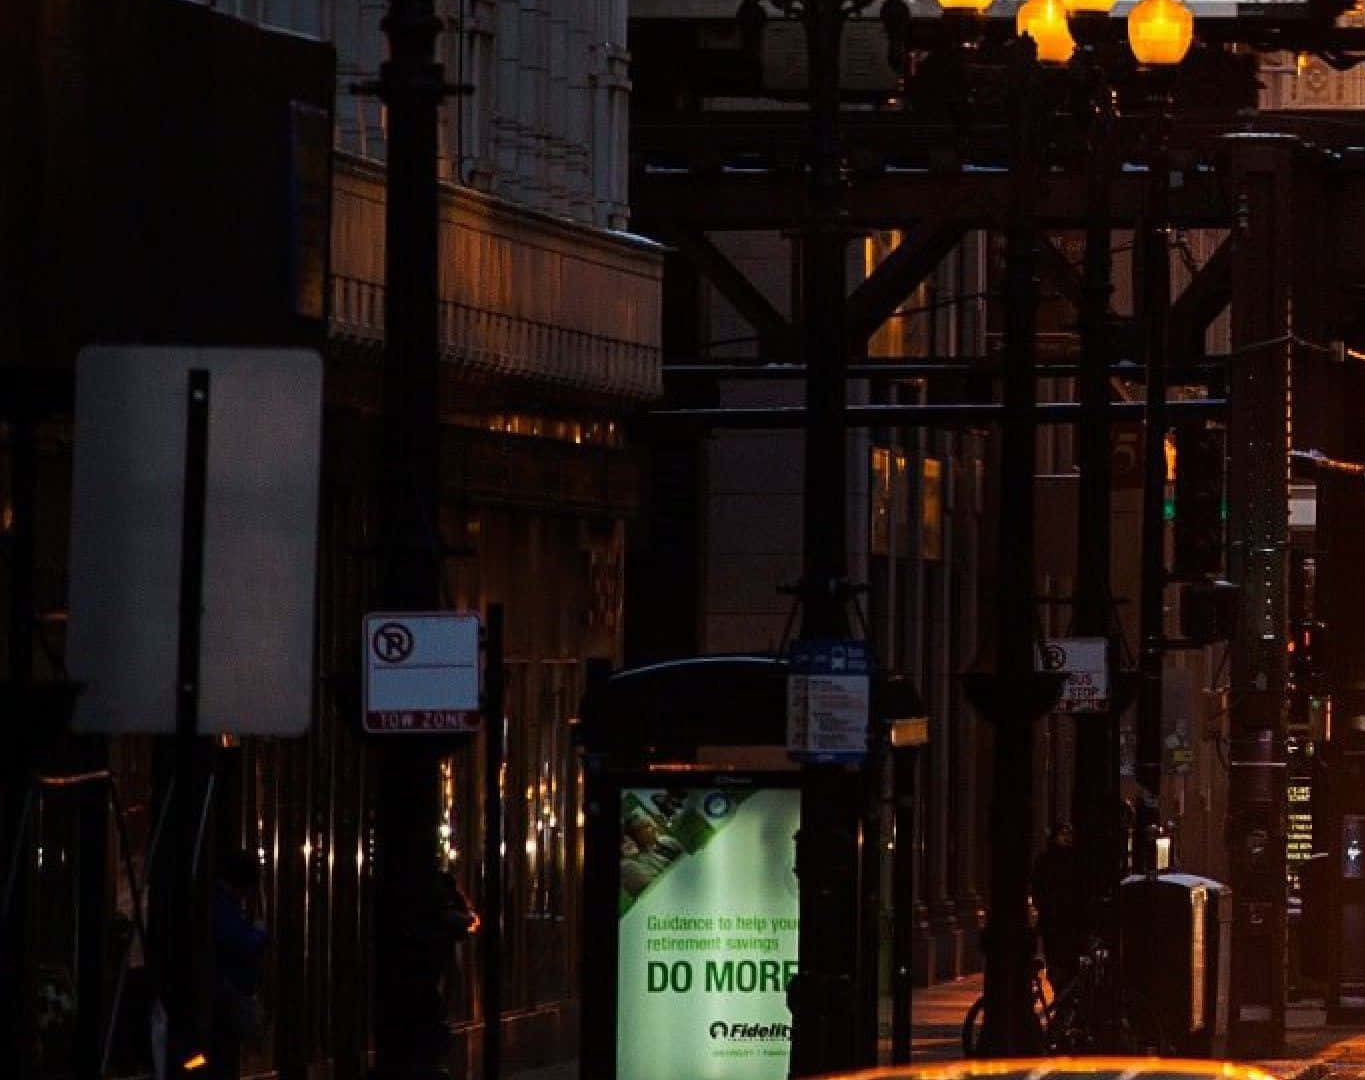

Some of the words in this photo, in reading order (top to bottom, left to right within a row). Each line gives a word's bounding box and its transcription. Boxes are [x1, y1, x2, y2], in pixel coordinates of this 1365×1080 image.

[381, 711, 414, 728] TOW
[647, 915, 713, 931] Guidance
[719, 916, 732, 931] to
[735, 914, 767, 934] help
[647, 937, 721, 951] retirement
[726, 938, 780, 954] savings
[647, 961, 693, 994] DO
